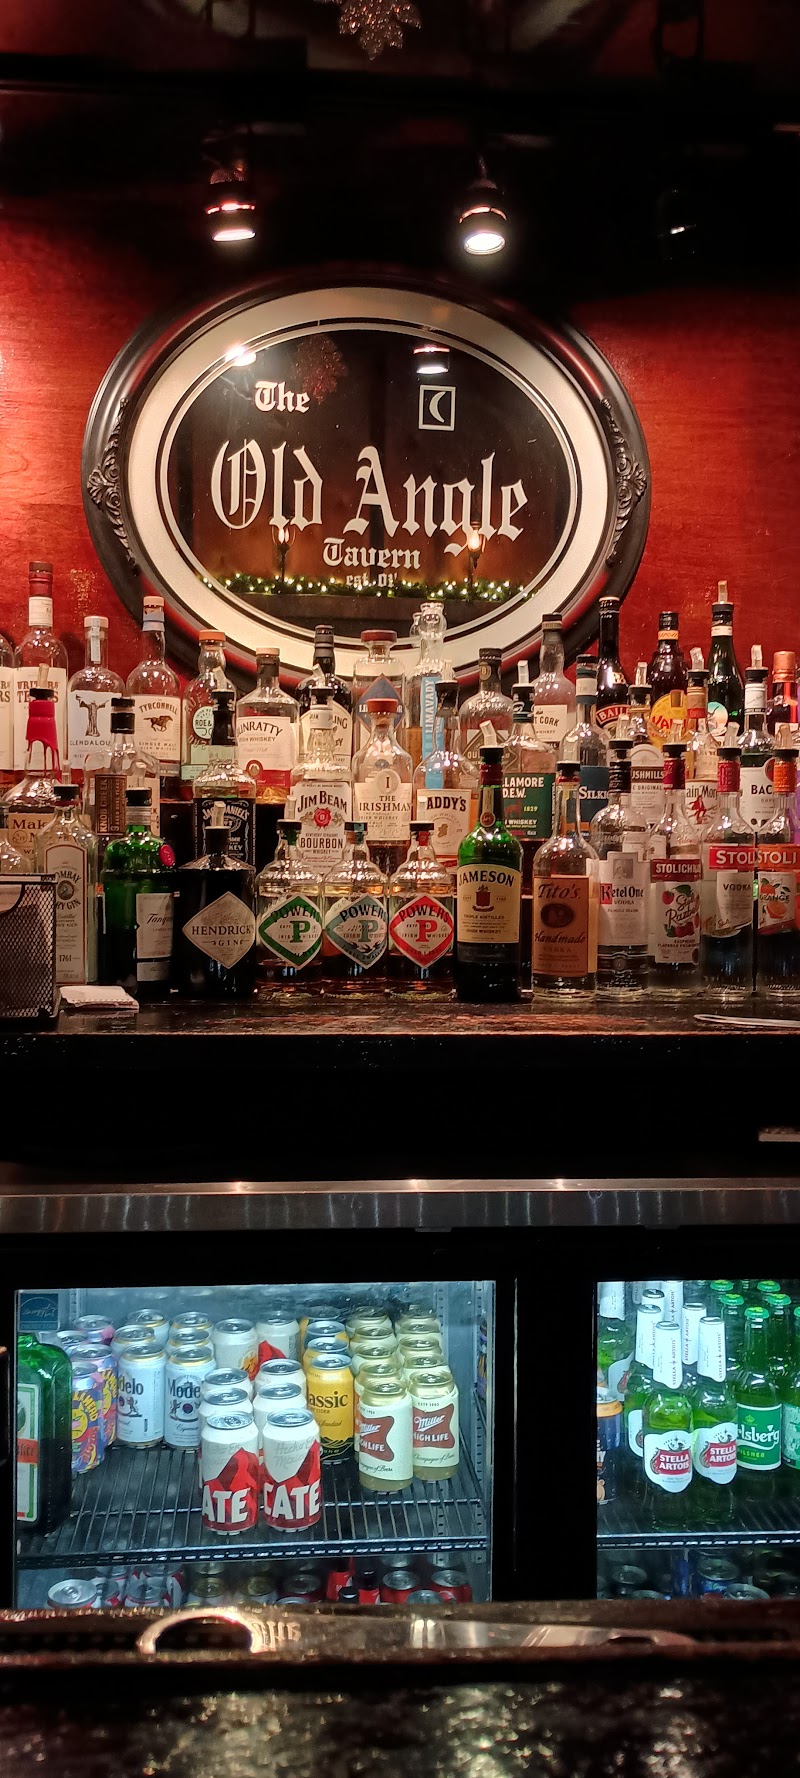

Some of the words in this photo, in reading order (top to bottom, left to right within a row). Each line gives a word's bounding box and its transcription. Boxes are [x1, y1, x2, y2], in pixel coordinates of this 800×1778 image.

[254, 381, 310, 414] The
[211, 438, 323, 532] Old
[343, 445, 528, 557] Angle
[323, 537, 421, 570] Tavern
[138, 702, 178, 715] TYRCONNELL
[424, 679, 436, 734] LIMAVADY
[540, 716, 560, 727] CORK
[502, 777, 544, 788] LAMORE
[750, 784, 774, 794] BAC
[298, 794, 318, 813] JIM
[320, 790, 348, 816] BEAM
[426, 796, 466, 812] ADDY'S
[225, 805, 250, 822] ANIEL'S
[300, 838, 343, 849] BOURBON
[716, 850, 756, 864] STOL
[459, 870, 514, 888] JAMESON
[538, 882, 581, 899] Tito's
[601, 886, 627, 901] Ketel
[628, 886, 644, 898] One
[398, 904, 450, 922] POWERS
[290, 920, 311, 943] P
[358, 920, 378, 942] P
[415, 920, 437, 942] P
[534, 930, 586, 943] Handmade
[119, 1375, 144, 1395] delo
[414, 1414, 446, 1432] Miller
[432, 1433, 449, 1442] LIFE
[368, 1442, 384, 1452] LIFE
[710, 1446, 736, 1457] STELLA
[659, 1462, 690, 1471] ARTOIS
[660, 1455, 690, 1463] STELLA
